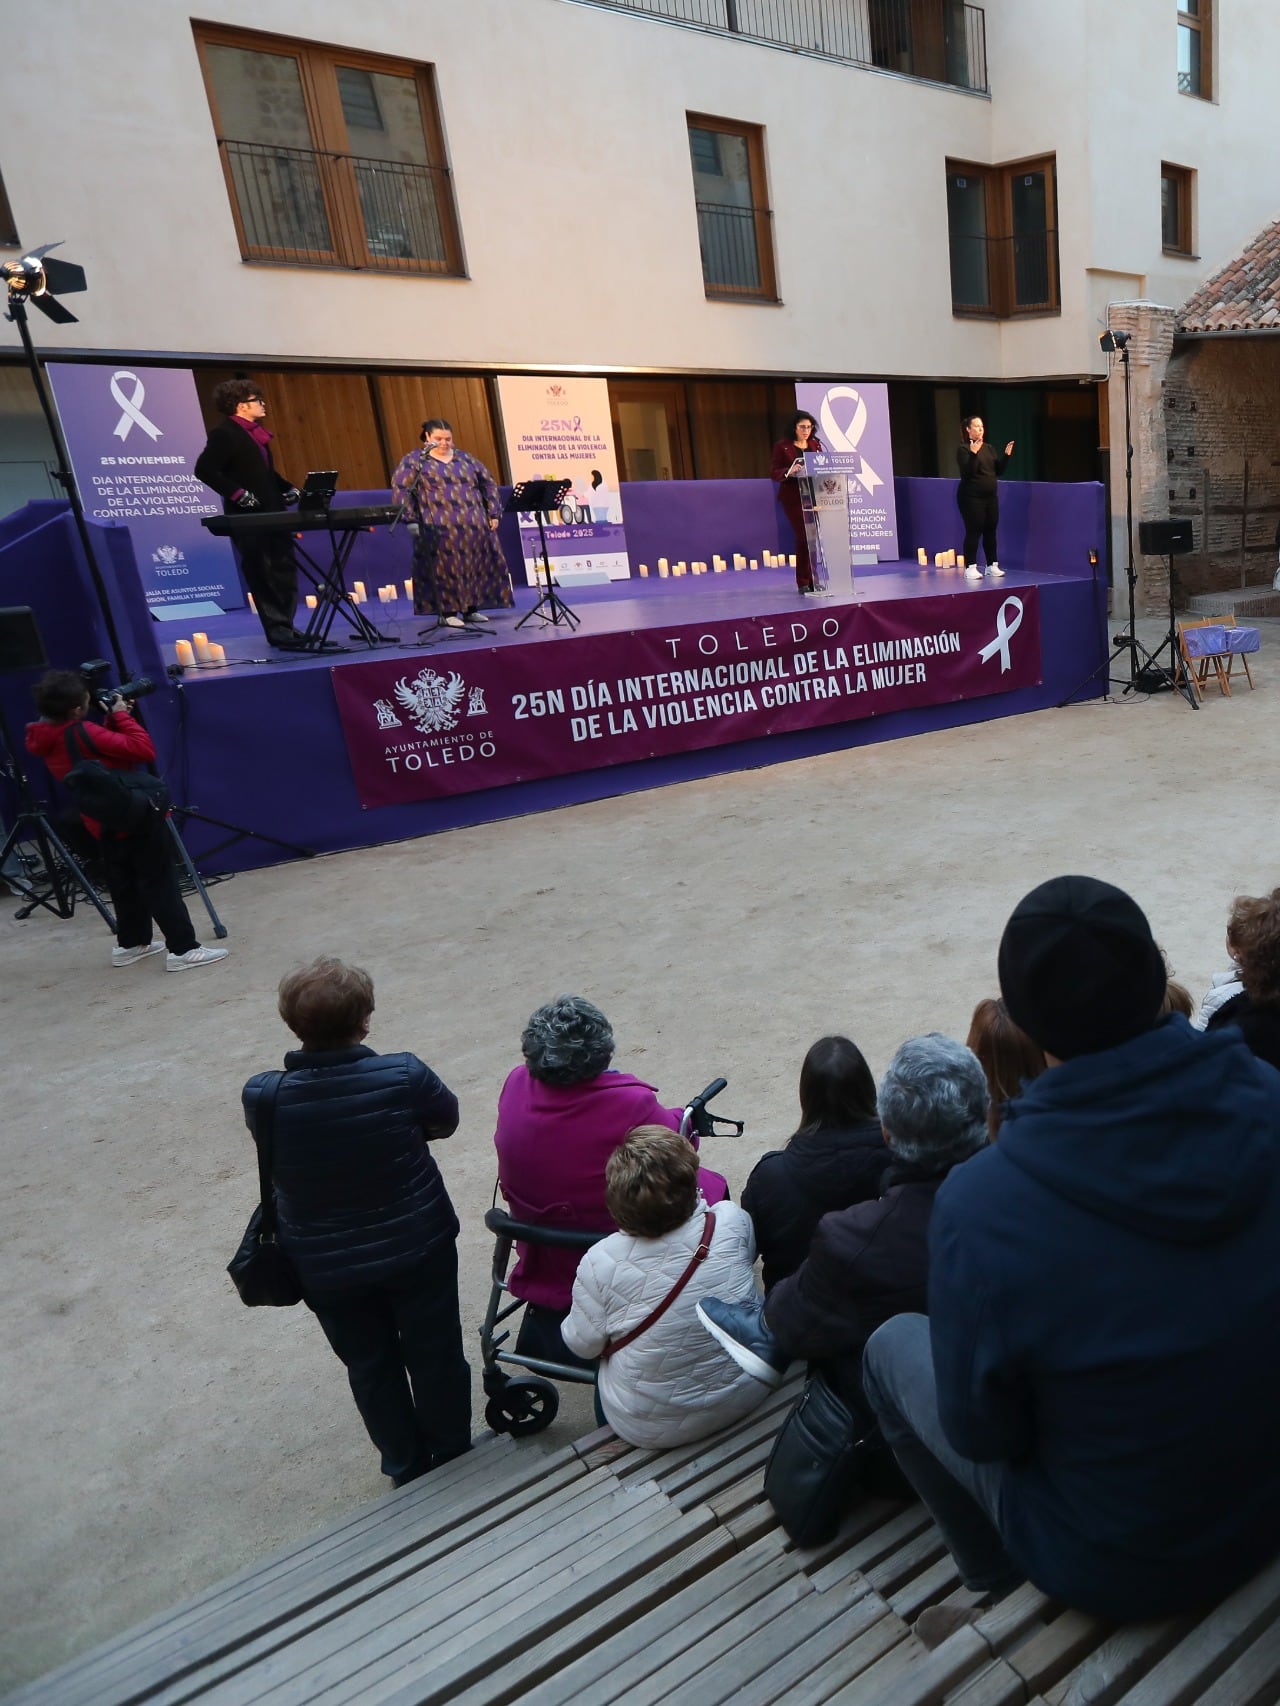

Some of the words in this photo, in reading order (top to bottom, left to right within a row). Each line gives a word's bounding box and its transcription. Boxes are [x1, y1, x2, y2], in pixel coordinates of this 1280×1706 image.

[540, 420, 572, 431] 25N
[518, 443, 557, 451] ELIMINACIÓN
[100, 456, 116, 465] 25
[117, 456, 186, 465] NOVIEMBRE
[115, 474, 202, 485] INTERNACIONA
[98, 487, 114, 496] DE
[116, 487, 132, 496] LA
[134, 484, 204, 495] ELIMINACIÓN
[107, 498, 124, 507] DE
[126, 497, 142, 506] LA
[142, 495, 201, 505] VIOLENCIA
[93, 508, 142, 518] CONTRA
[143, 507, 165, 516] LAS
[166, 505, 218, 515] MUJERES
[850, 515, 886, 523] MINACIÓN
[572, 529, 594, 537] 2025
[155, 568, 189, 577] TOLEDO
[665, 618, 839, 658] TOLEDO
[511, 689, 565, 720] 25N
[570, 679, 613, 711] DÍA
[617, 656, 790, 703] INTERNACIONAL
[793, 651, 819, 676] DE
[823, 647, 849, 671] LA
[853, 629, 961, 667] ELIMINACIÓN
[570, 715, 603, 742] DE
[607, 709, 639, 735] LA
[642, 689, 758, 729] VIOLENCIA
[760, 675, 841, 708] CONTRA
[844, 671, 868, 695] LA
[871, 662, 926, 690] MUJER
[384, 733, 474, 755] AYUNTAMIENTO
[479, 730, 494, 740] DE
[385, 742, 496, 773] TOLEDO
